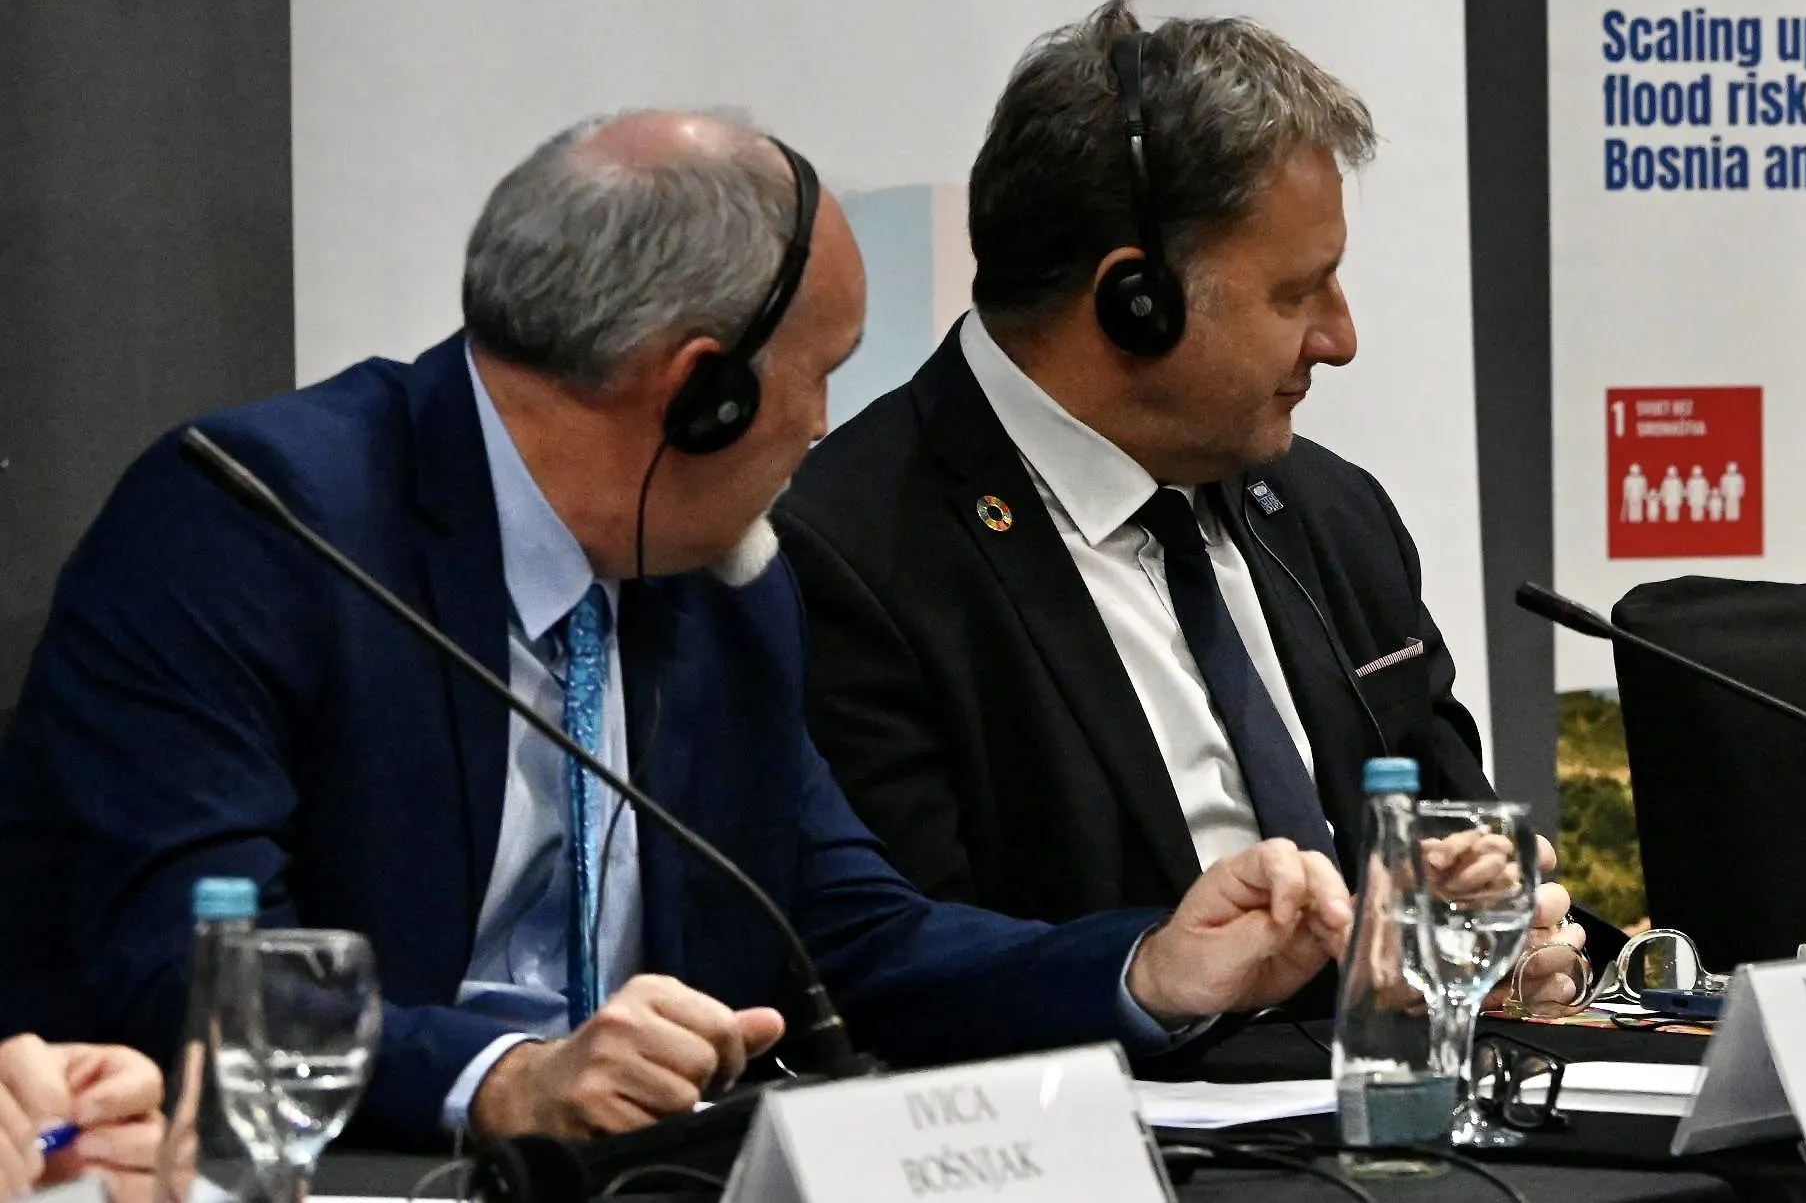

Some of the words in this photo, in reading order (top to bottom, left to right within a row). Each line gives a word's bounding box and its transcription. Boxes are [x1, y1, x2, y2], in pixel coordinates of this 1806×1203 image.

[1602, 7, 1762, 69] Scaling
[1603, 73, 1712, 127] flood
[1604, 135, 1750, 191] Bosnia
[1611, 399, 1626, 438] 1
[905, 1085, 999, 1131] IVICA
